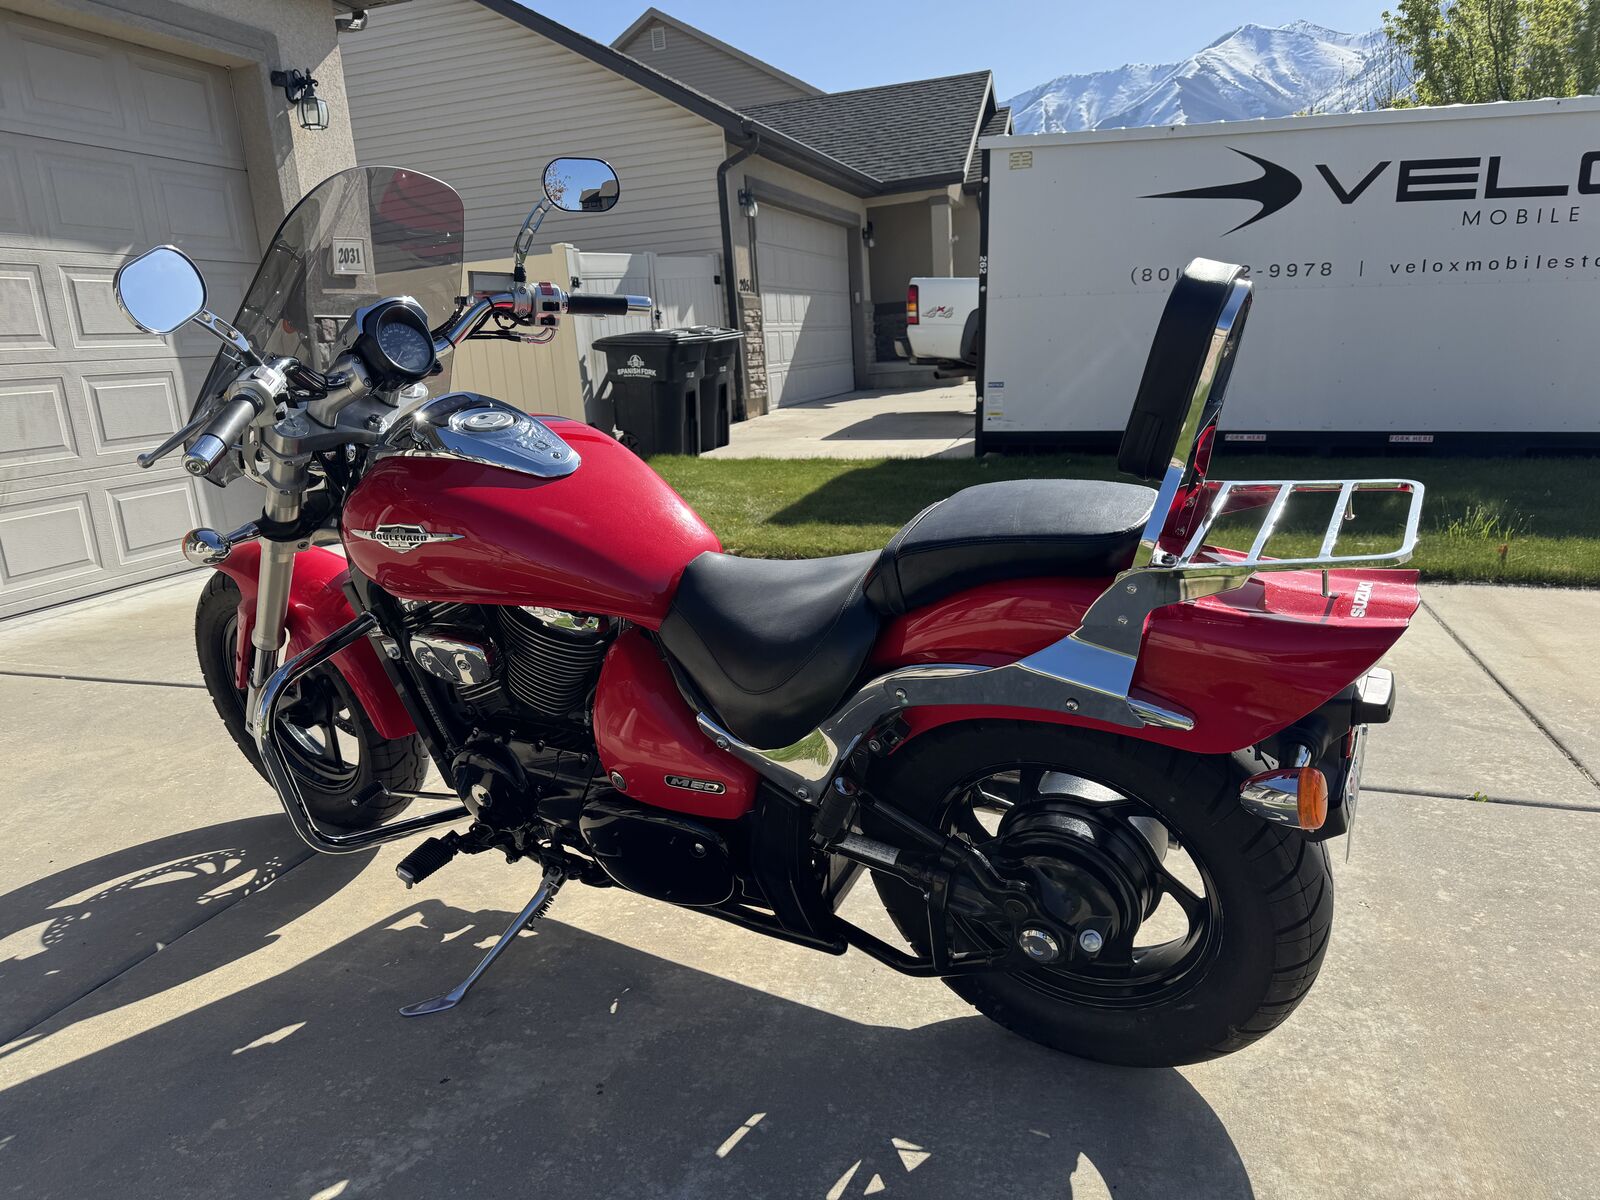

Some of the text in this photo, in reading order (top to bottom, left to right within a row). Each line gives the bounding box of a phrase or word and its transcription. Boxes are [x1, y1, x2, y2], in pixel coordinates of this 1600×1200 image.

[1315, 151, 1600, 205] VEL
[1462, 206, 1580, 226] MOBILE
[338, 248, 361, 264] 2031
[979, 256, 987, 275] 262
[1131, 266, 1180, 285] (801
[1242, 262, 1333, 279] 2-9978
[641, 368, 657, 377] FORK
[371, 532, 428, 542] BOULEVARD
[1350, 581, 1374, 618] SUZUKI
